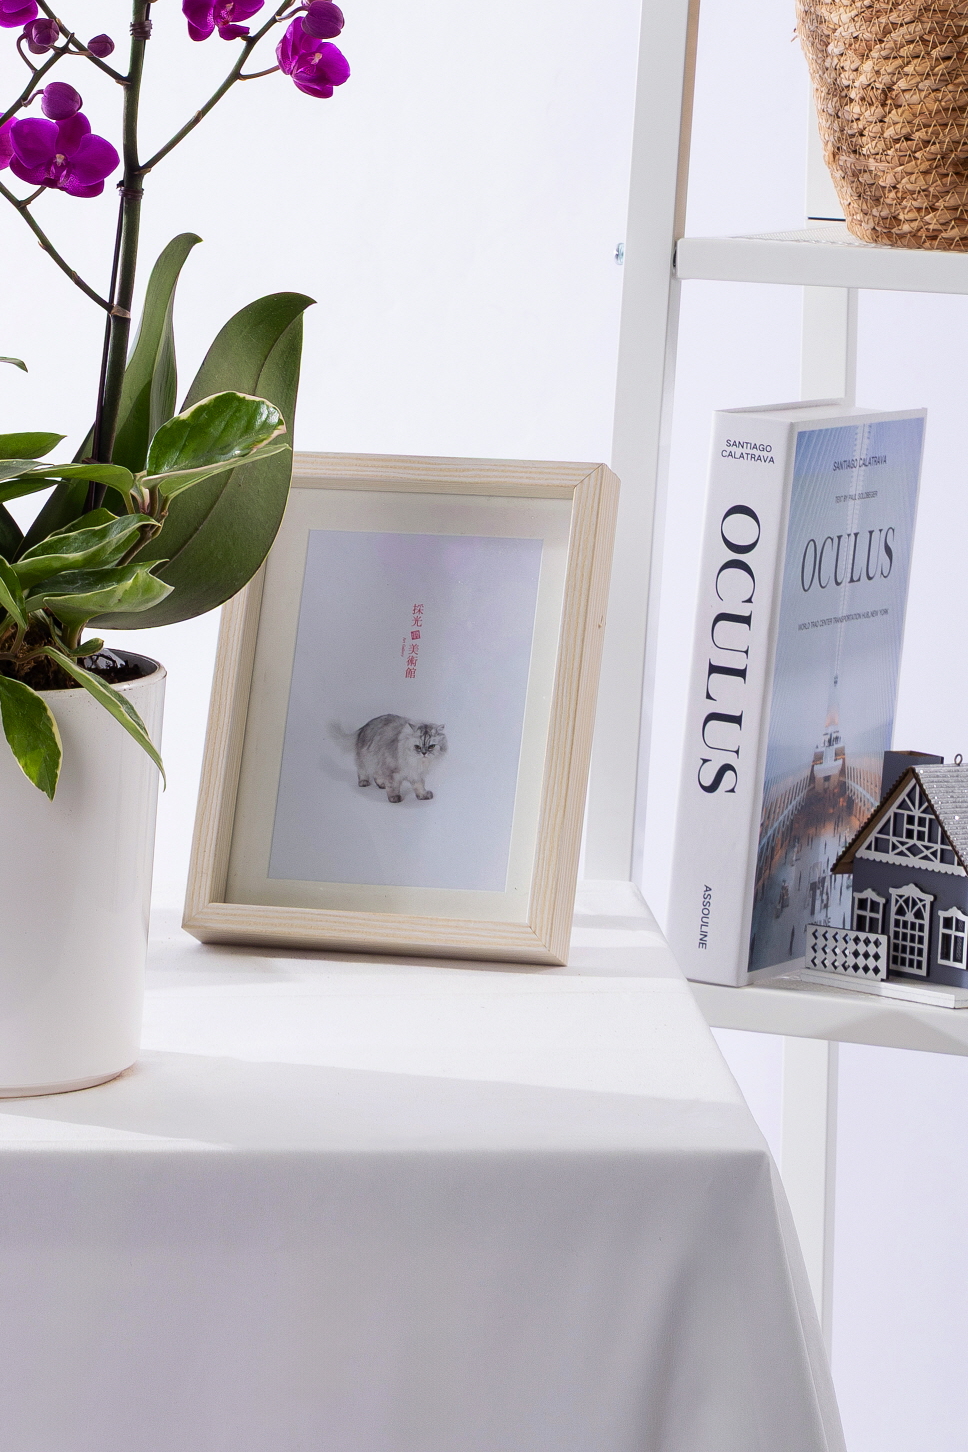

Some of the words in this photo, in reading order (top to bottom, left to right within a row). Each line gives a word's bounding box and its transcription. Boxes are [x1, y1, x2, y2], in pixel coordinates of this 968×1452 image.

[721, 449, 775, 464] CALATRAVA
[725, 439, 772, 453] SANTIAGO
[833, 458, 858, 471] SANTIAGO
[858, 455, 887, 468] CALATRAVA
[801, 526, 895, 592] OCULUS
[698, 504, 761, 794] OCULUS
[698, 884, 713, 950] ASSOULINE
